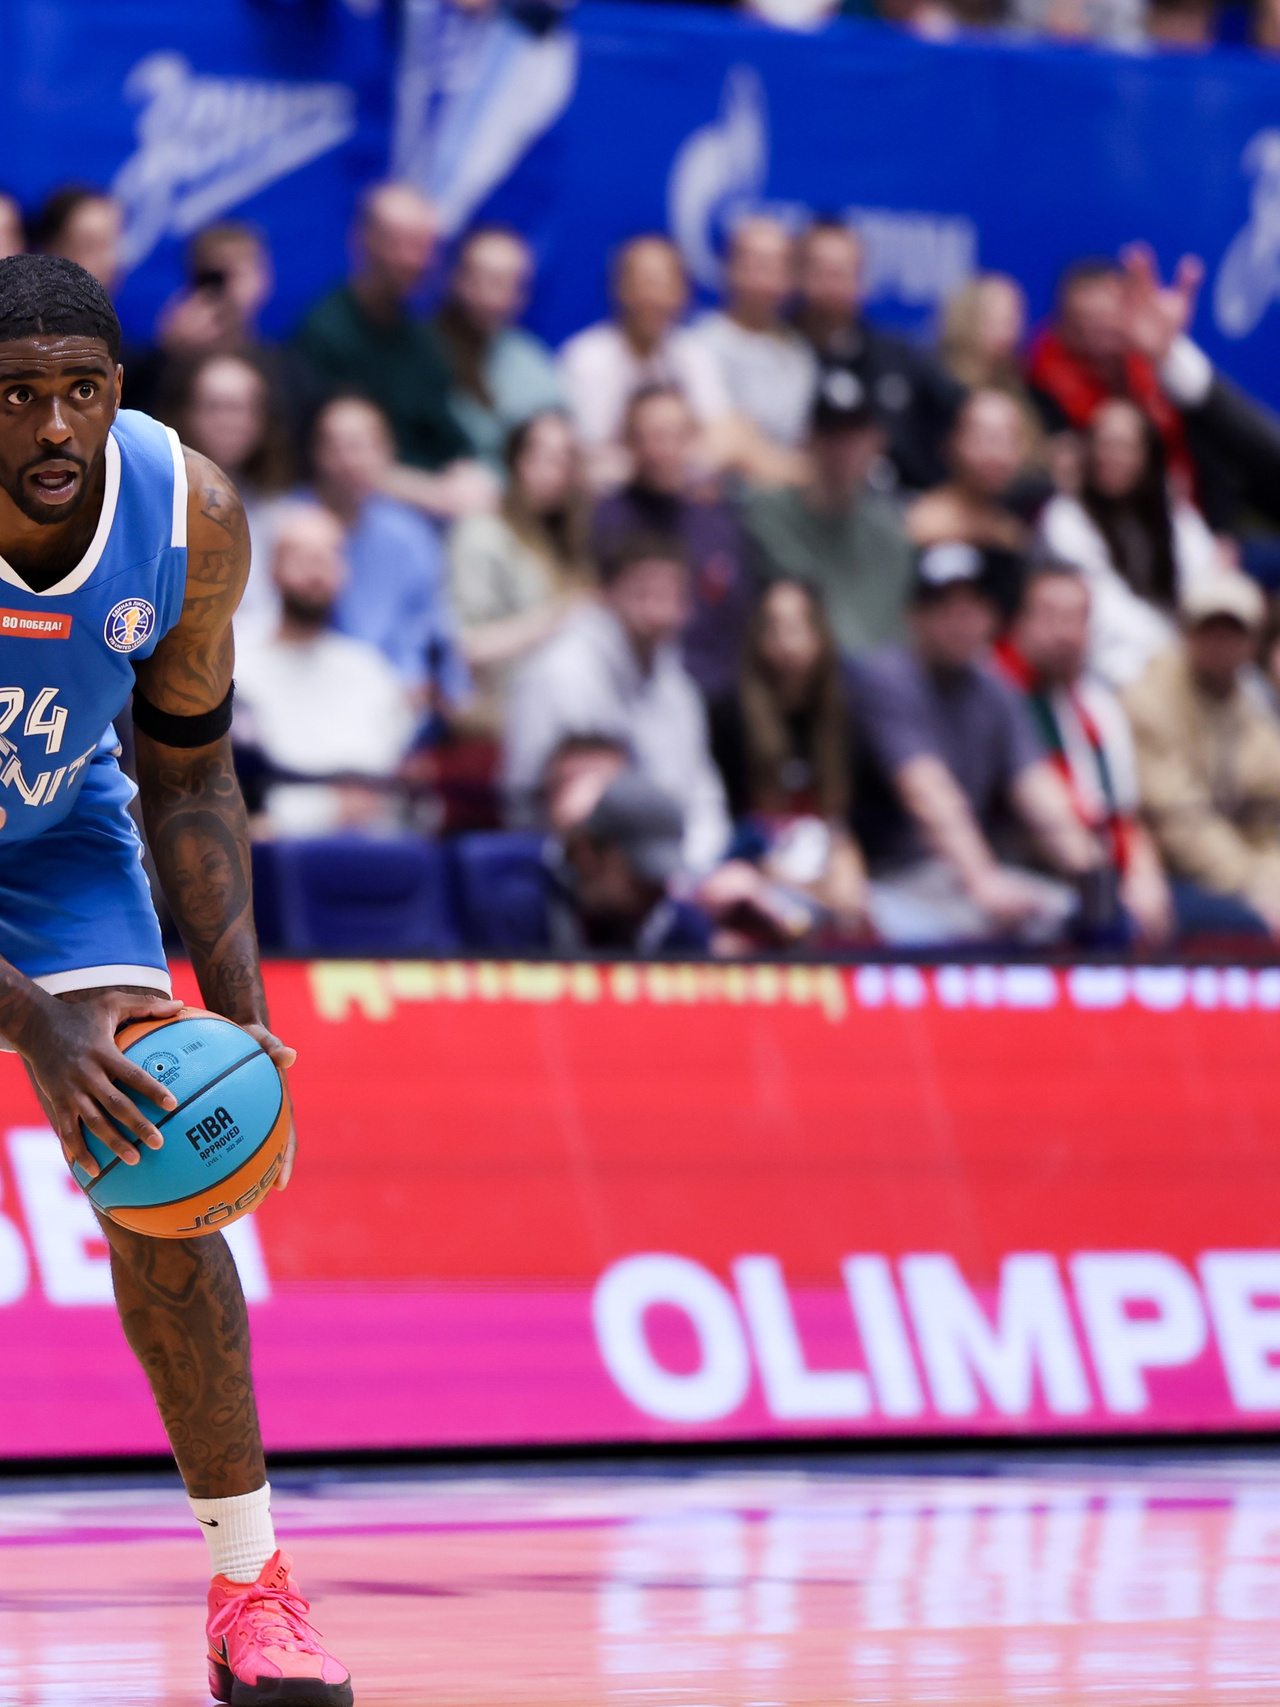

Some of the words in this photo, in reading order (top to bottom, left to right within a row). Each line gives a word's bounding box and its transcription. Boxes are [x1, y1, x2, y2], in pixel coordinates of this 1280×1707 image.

[2, 616, 18, 629] 80
[19, 619, 62, 631] ПОБЕДА!
[157, 1066, 181, 1083] ÖGEL
[185, 1106, 234, 1151] FIBA
[199, 1125, 240, 1161] APPROVED
